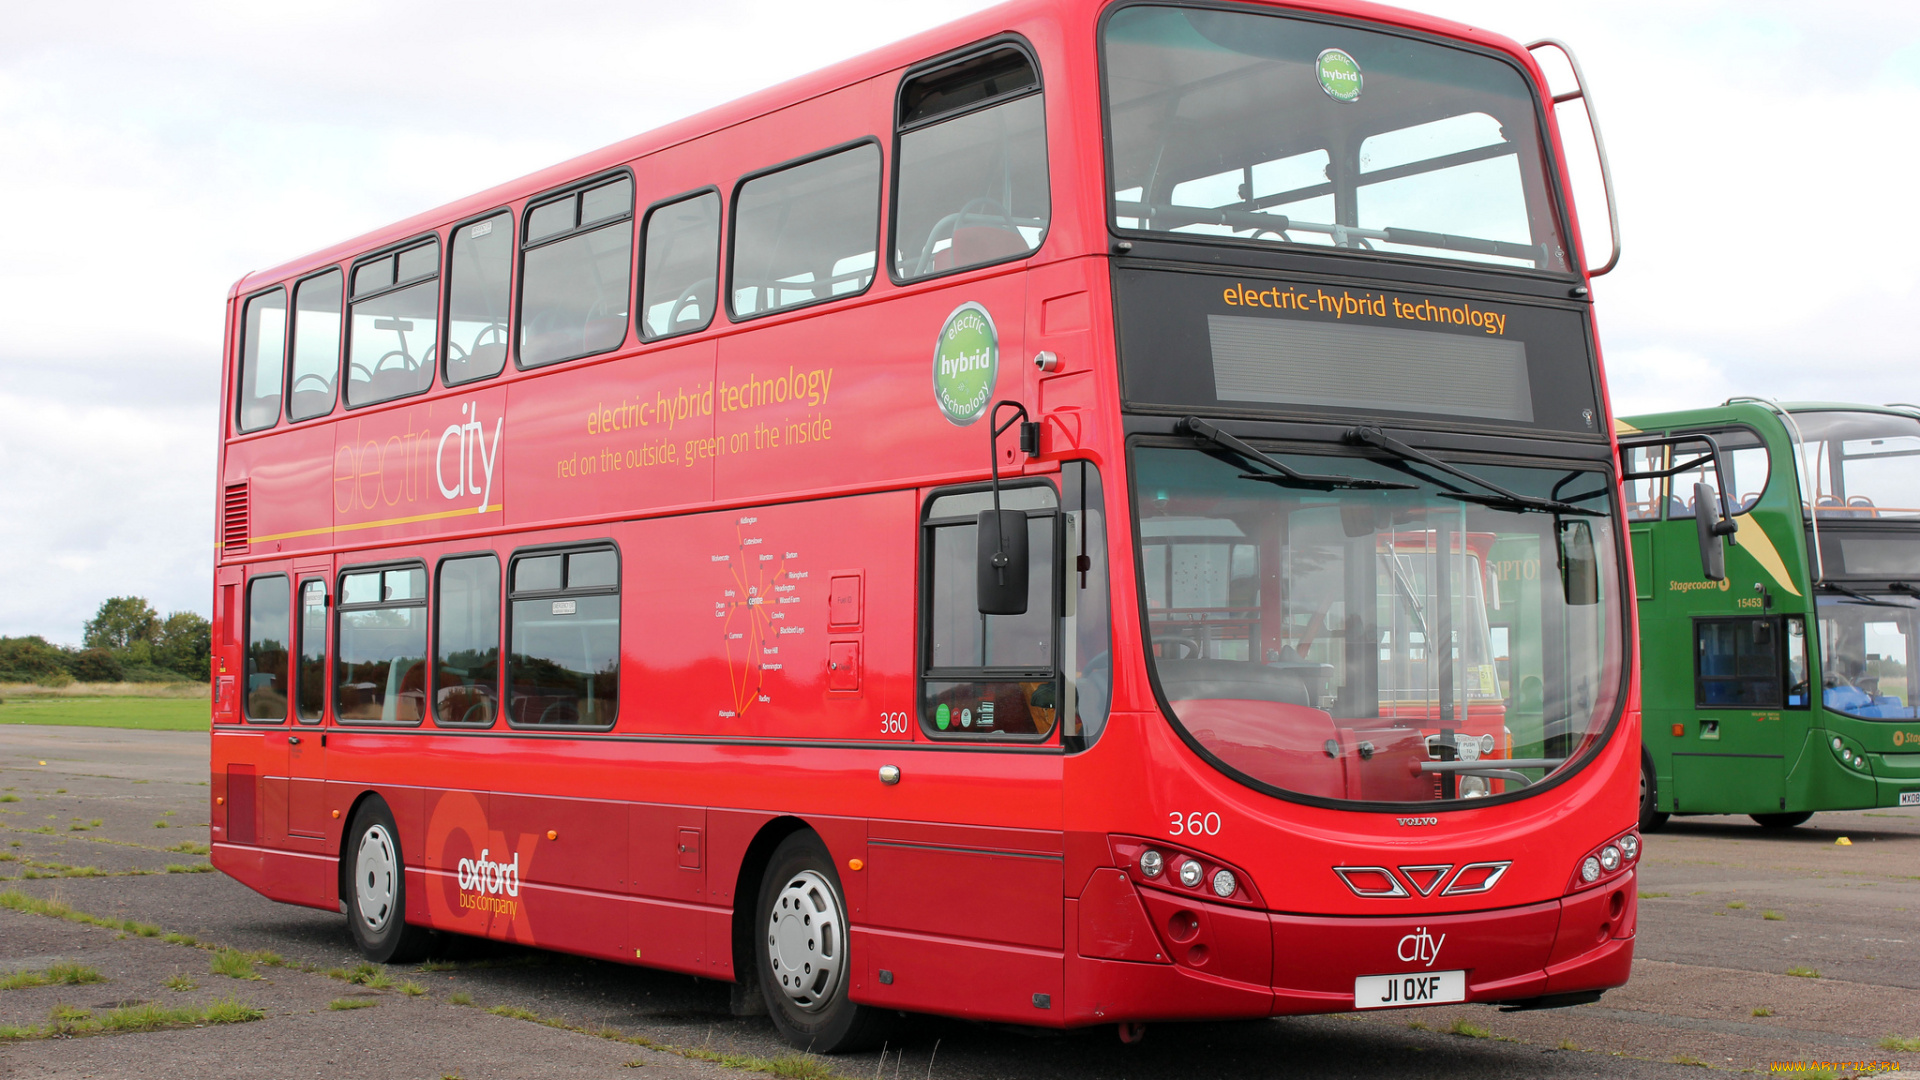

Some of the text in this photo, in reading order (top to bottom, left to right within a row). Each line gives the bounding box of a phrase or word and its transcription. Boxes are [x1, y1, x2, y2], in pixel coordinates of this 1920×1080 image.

[1324, 53, 1351, 66] electric
[1322, 68, 1358, 82] hybrid
[1325, 83, 1360, 99] technology
[1223, 283, 1506, 335] electric-hybrid technology
[948, 314, 985, 340] electric
[941, 347, 990, 379] hybrid
[587, 365, 833, 435] electric-hybrid technology
[941, 381, 989, 415] technology
[557, 412, 832, 478] red on the outside, green on the inside
[1670, 580, 1717, 593] Stagecoach
[1737, 598, 1762, 608] 15453
[880, 712, 907, 734] 360
[1168, 811, 1222, 836] 360
[1396, 817, 1438, 826] VOLVO
[458, 849, 519, 897] oxford
[460, 889, 518, 920] bus company
[1397, 926, 1446, 967] city
[1404, 976, 1441, 1000] OXF
